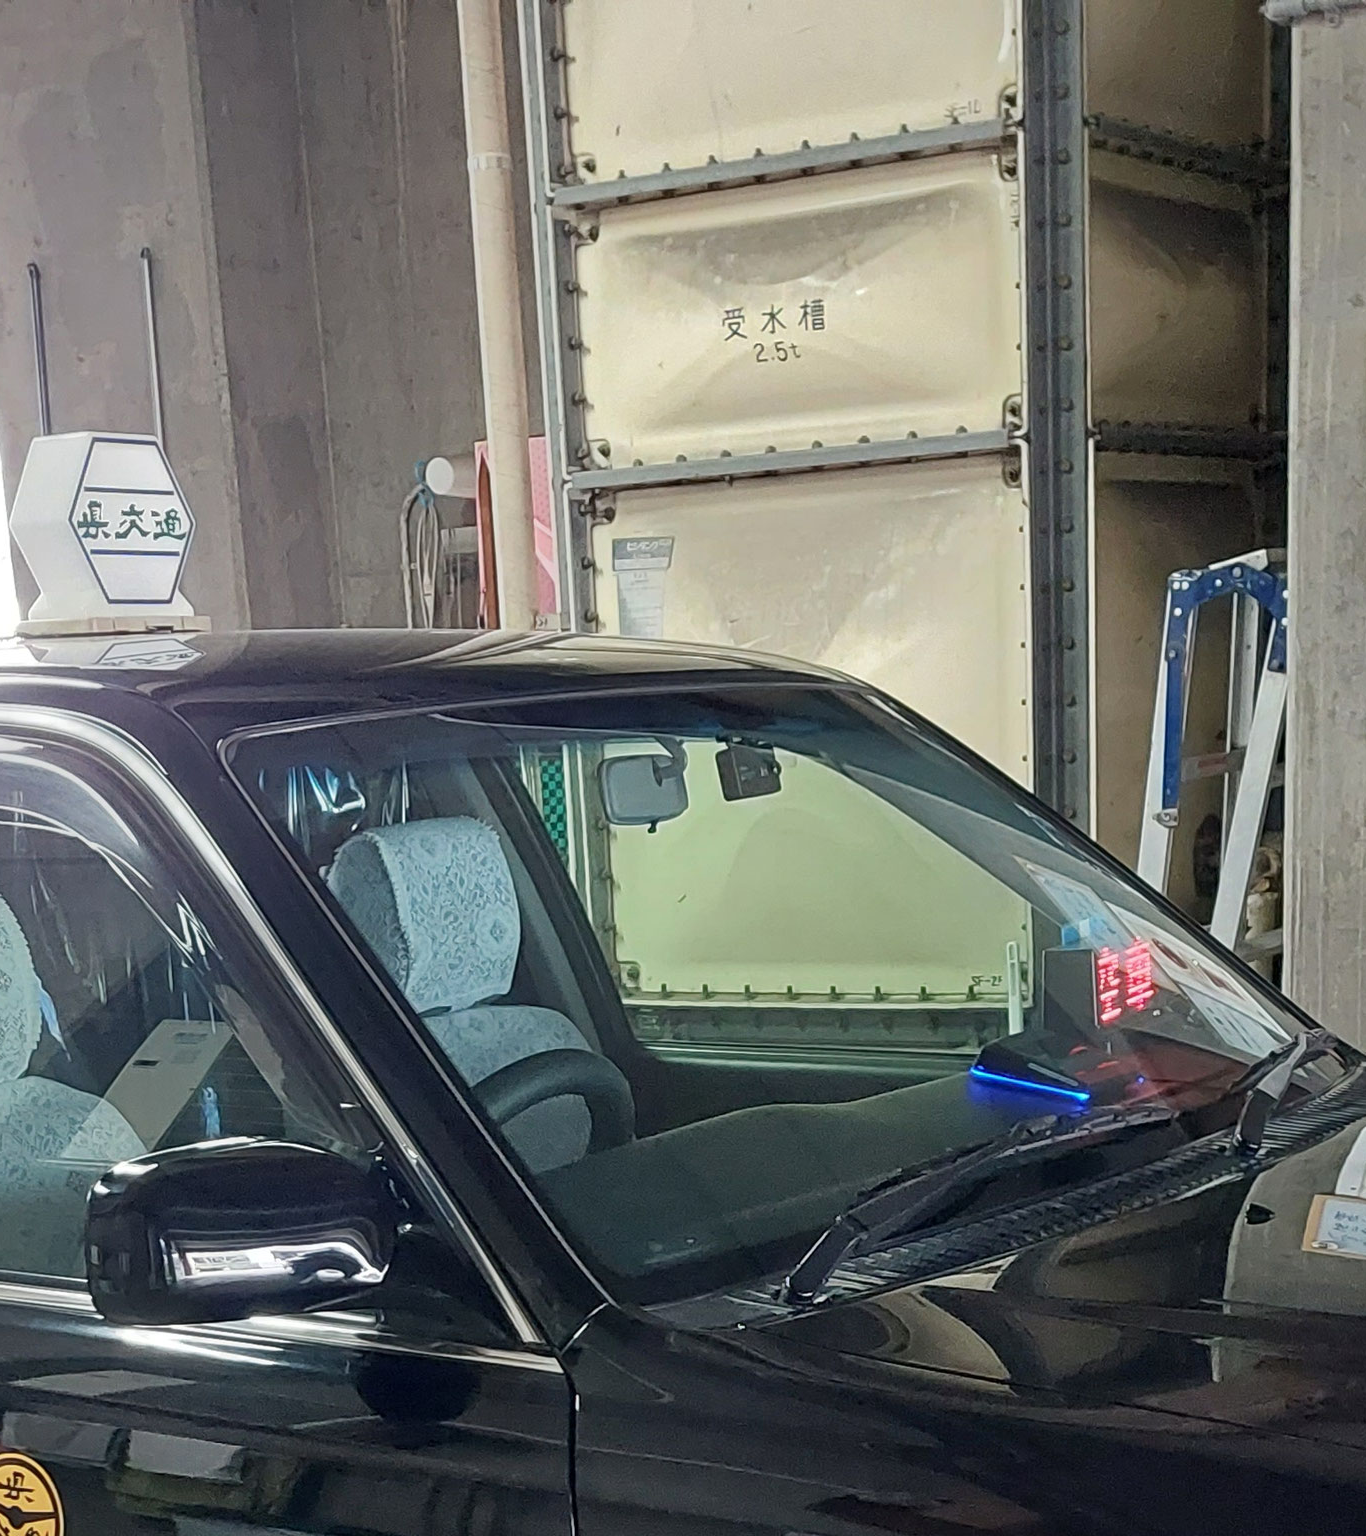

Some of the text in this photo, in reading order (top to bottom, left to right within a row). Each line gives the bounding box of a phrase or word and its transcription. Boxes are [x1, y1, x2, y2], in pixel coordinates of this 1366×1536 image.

[721, 298, 826, 342] 受水槽
[753, 341, 802, 363] 2.5t
[76, 499, 187, 542] 県交通
